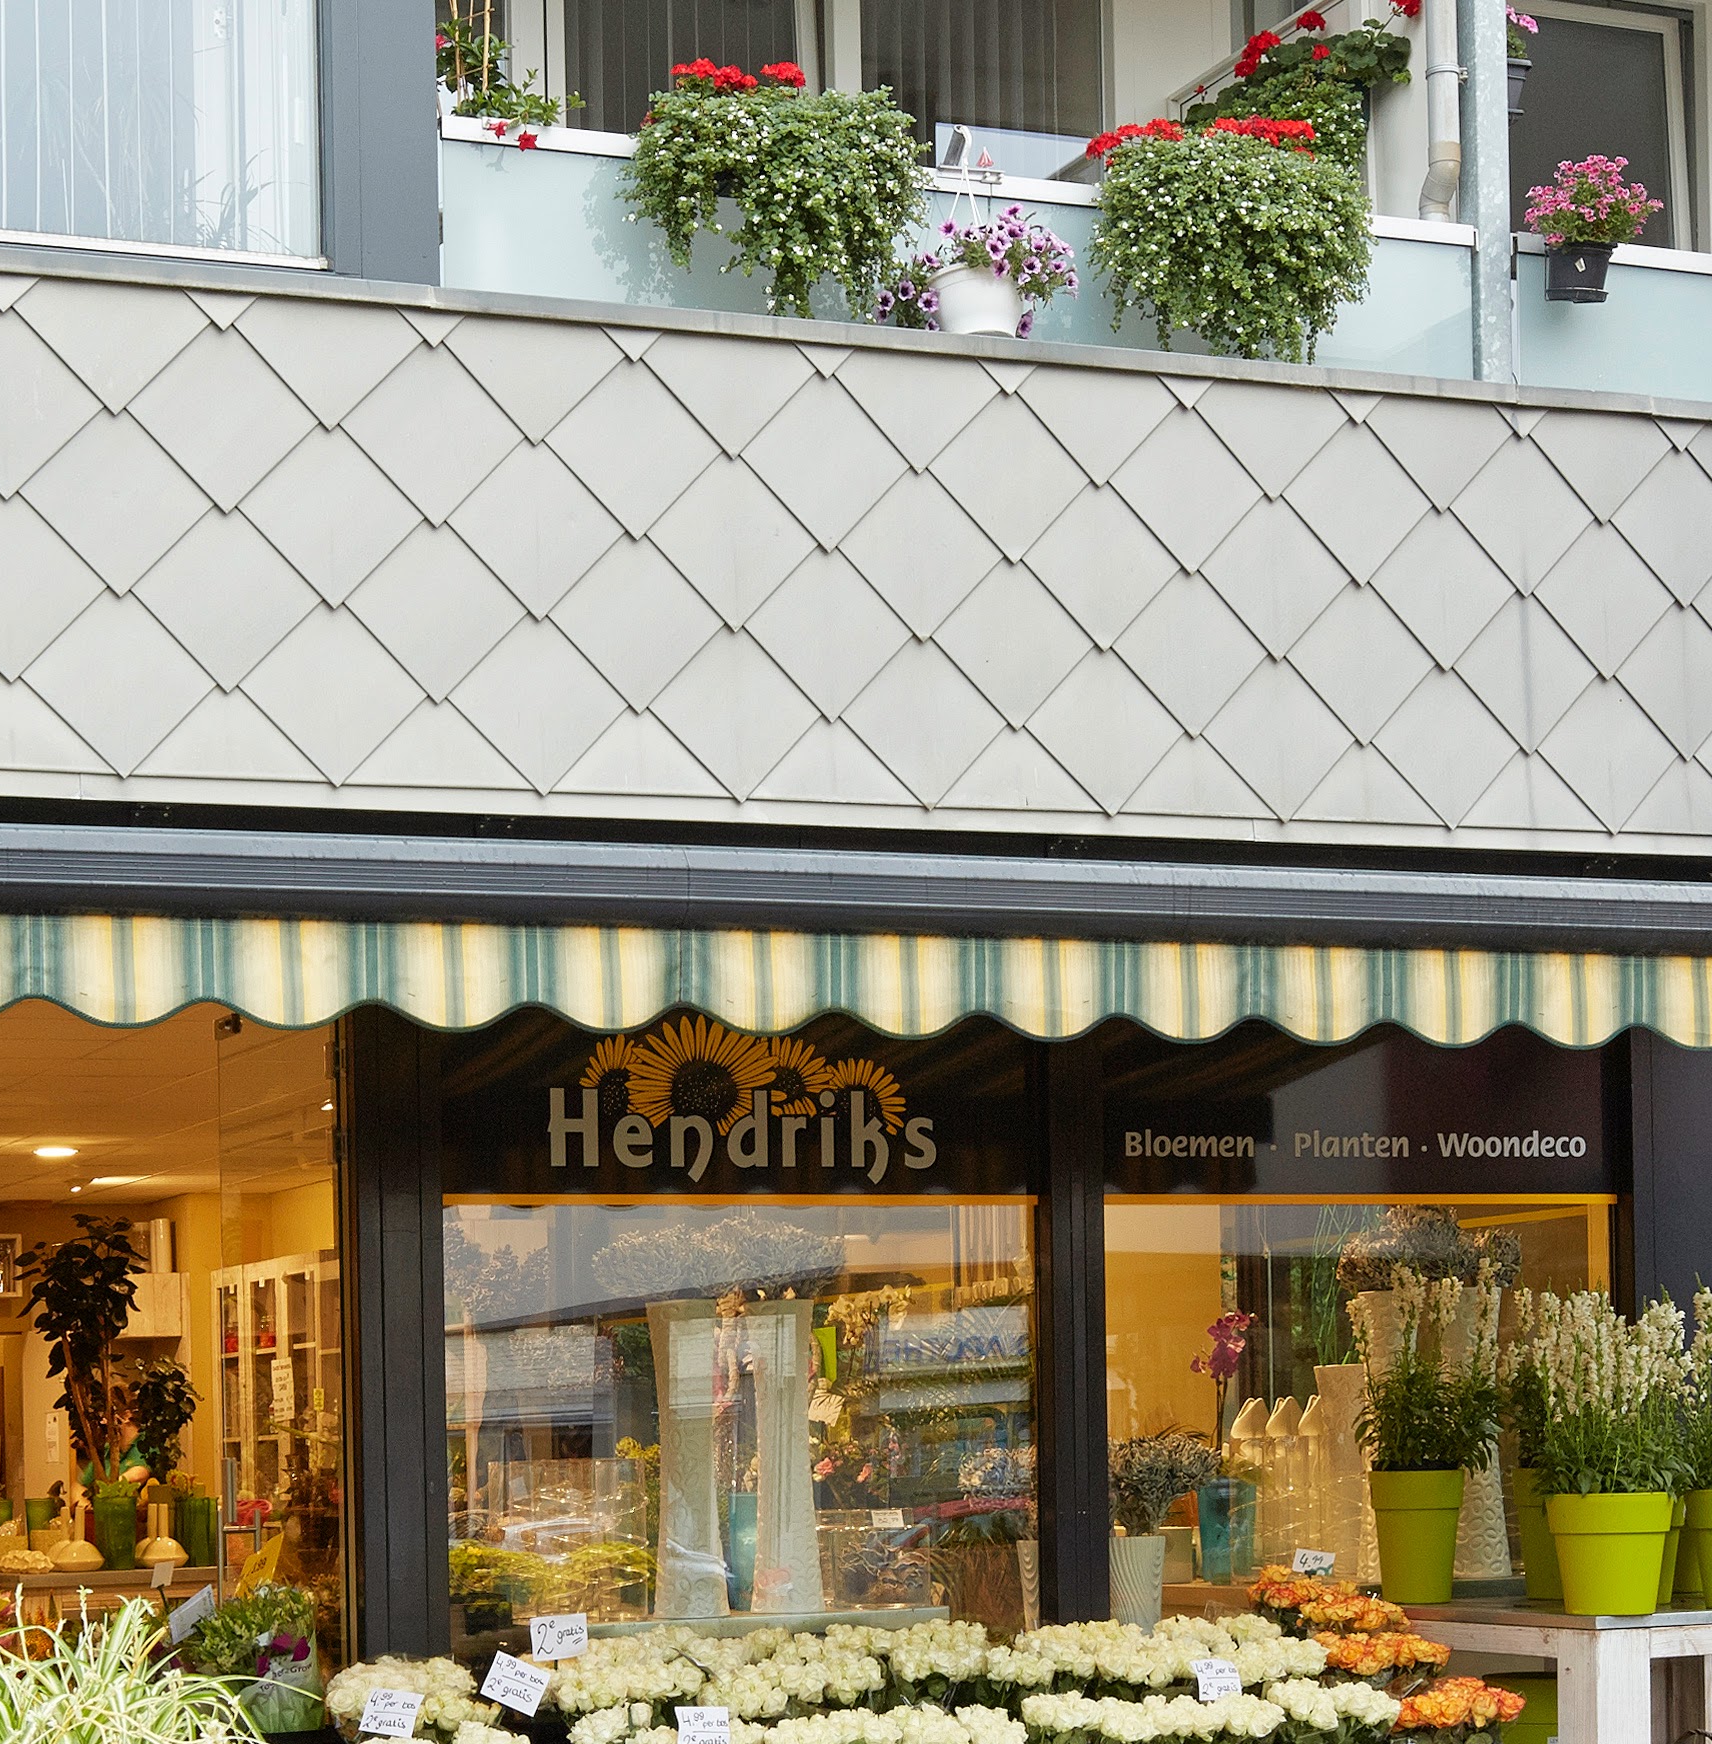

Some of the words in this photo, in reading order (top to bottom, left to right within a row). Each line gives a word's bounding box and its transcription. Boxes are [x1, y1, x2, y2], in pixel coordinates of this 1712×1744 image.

[547, 1087, 937, 1184] Hendriks
[1124, 1131, 1255, 1158] Bloemen
[1294, 1132, 1410, 1158] Planten
[1437, 1130, 1587, 1158] Woondeco
[536, 1618, 557, 1656] 2e
[556, 1624, 586, 1645] gratis
[513, 1668, 528, 1679] per
[500, 1685, 533, 1704] gratis
[384, 1700, 399, 1710] per
[401, 1700, 417, 1710] bos
[375, 1715, 407, 1730] gratis
[702, 1721, 714, 1729] per
